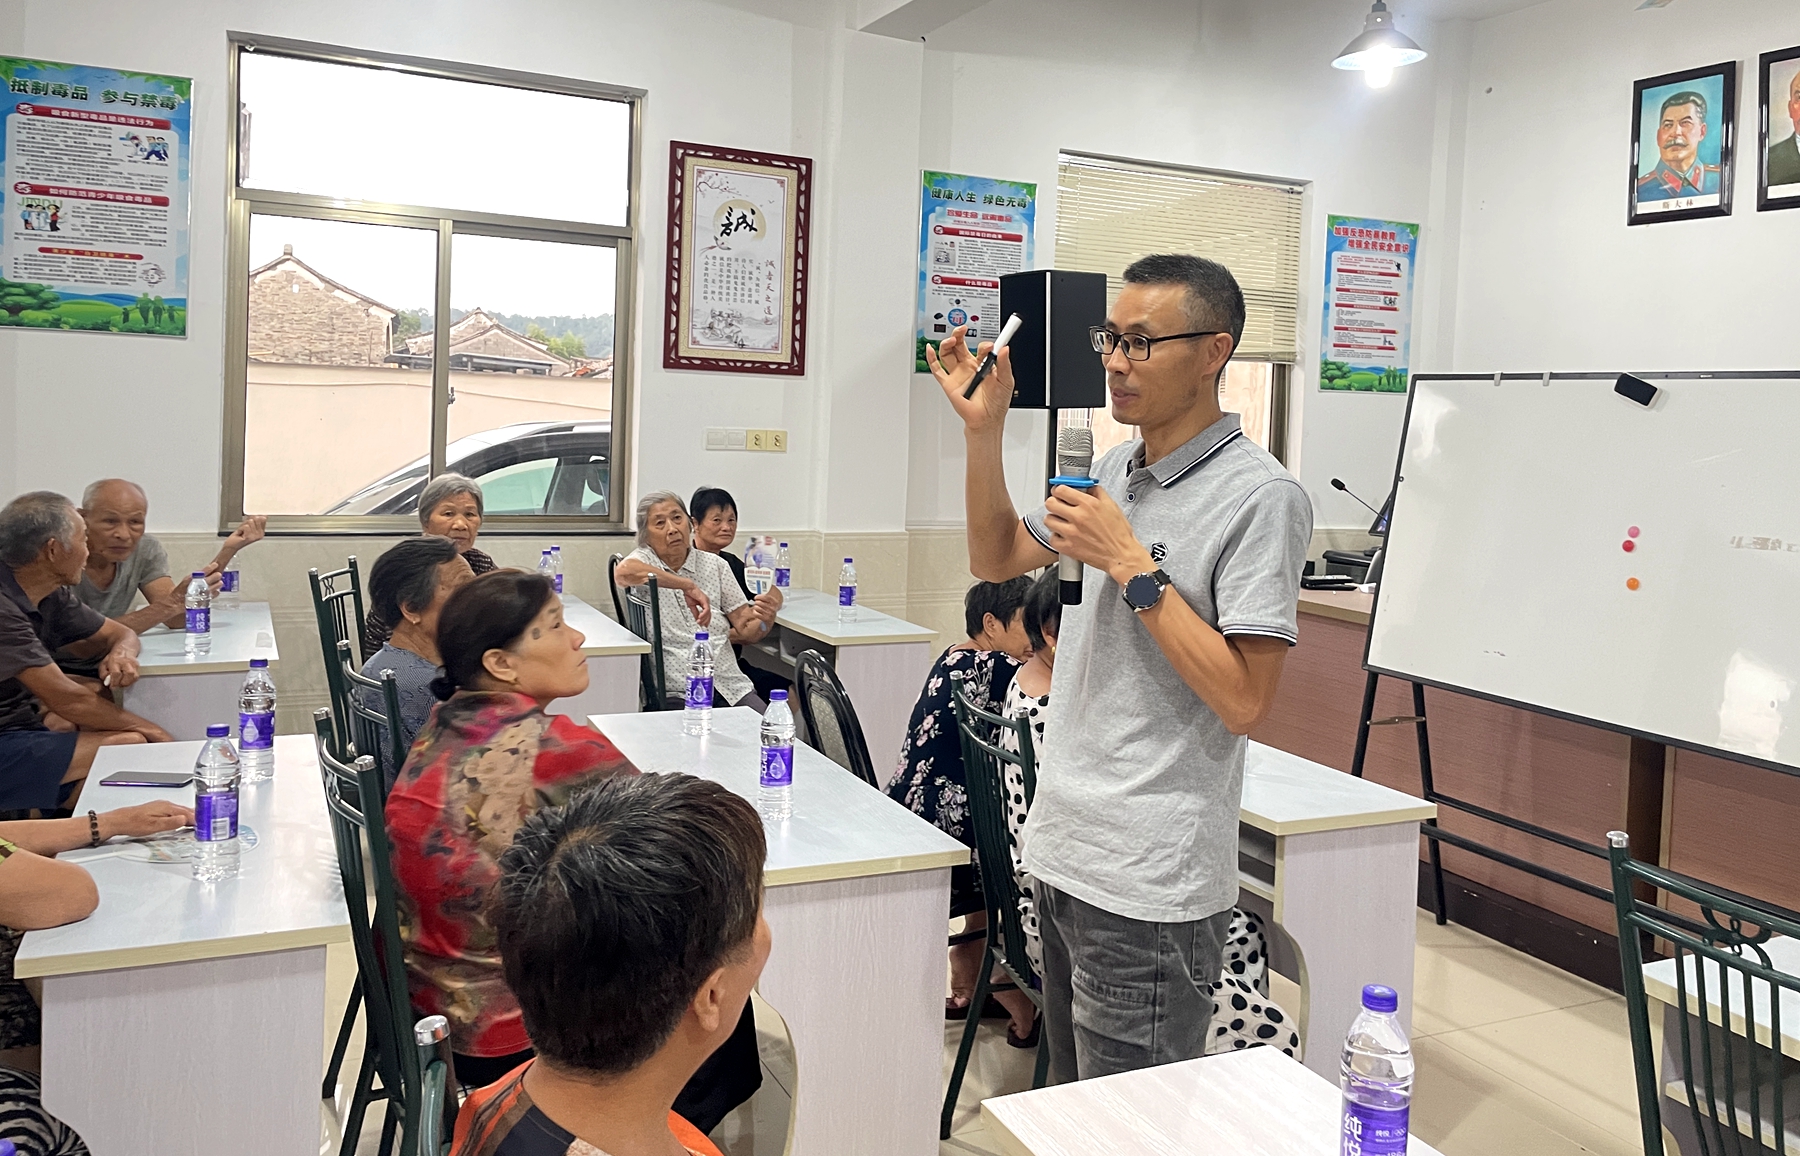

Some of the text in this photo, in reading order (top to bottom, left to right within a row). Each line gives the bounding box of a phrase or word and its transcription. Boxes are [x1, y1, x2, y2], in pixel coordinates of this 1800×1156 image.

[10, 78, 179, 111] 抵制毒品 参与禁毒
[931, 188, 1028, 209] 健康人生 绿色无毒
[1662, 199, 1694, 209] 斯大林
[1334, 226, 1396, 241] 加强反恐防暴教育
[1348, 239, 1409, 253] 增强全民安全意识
